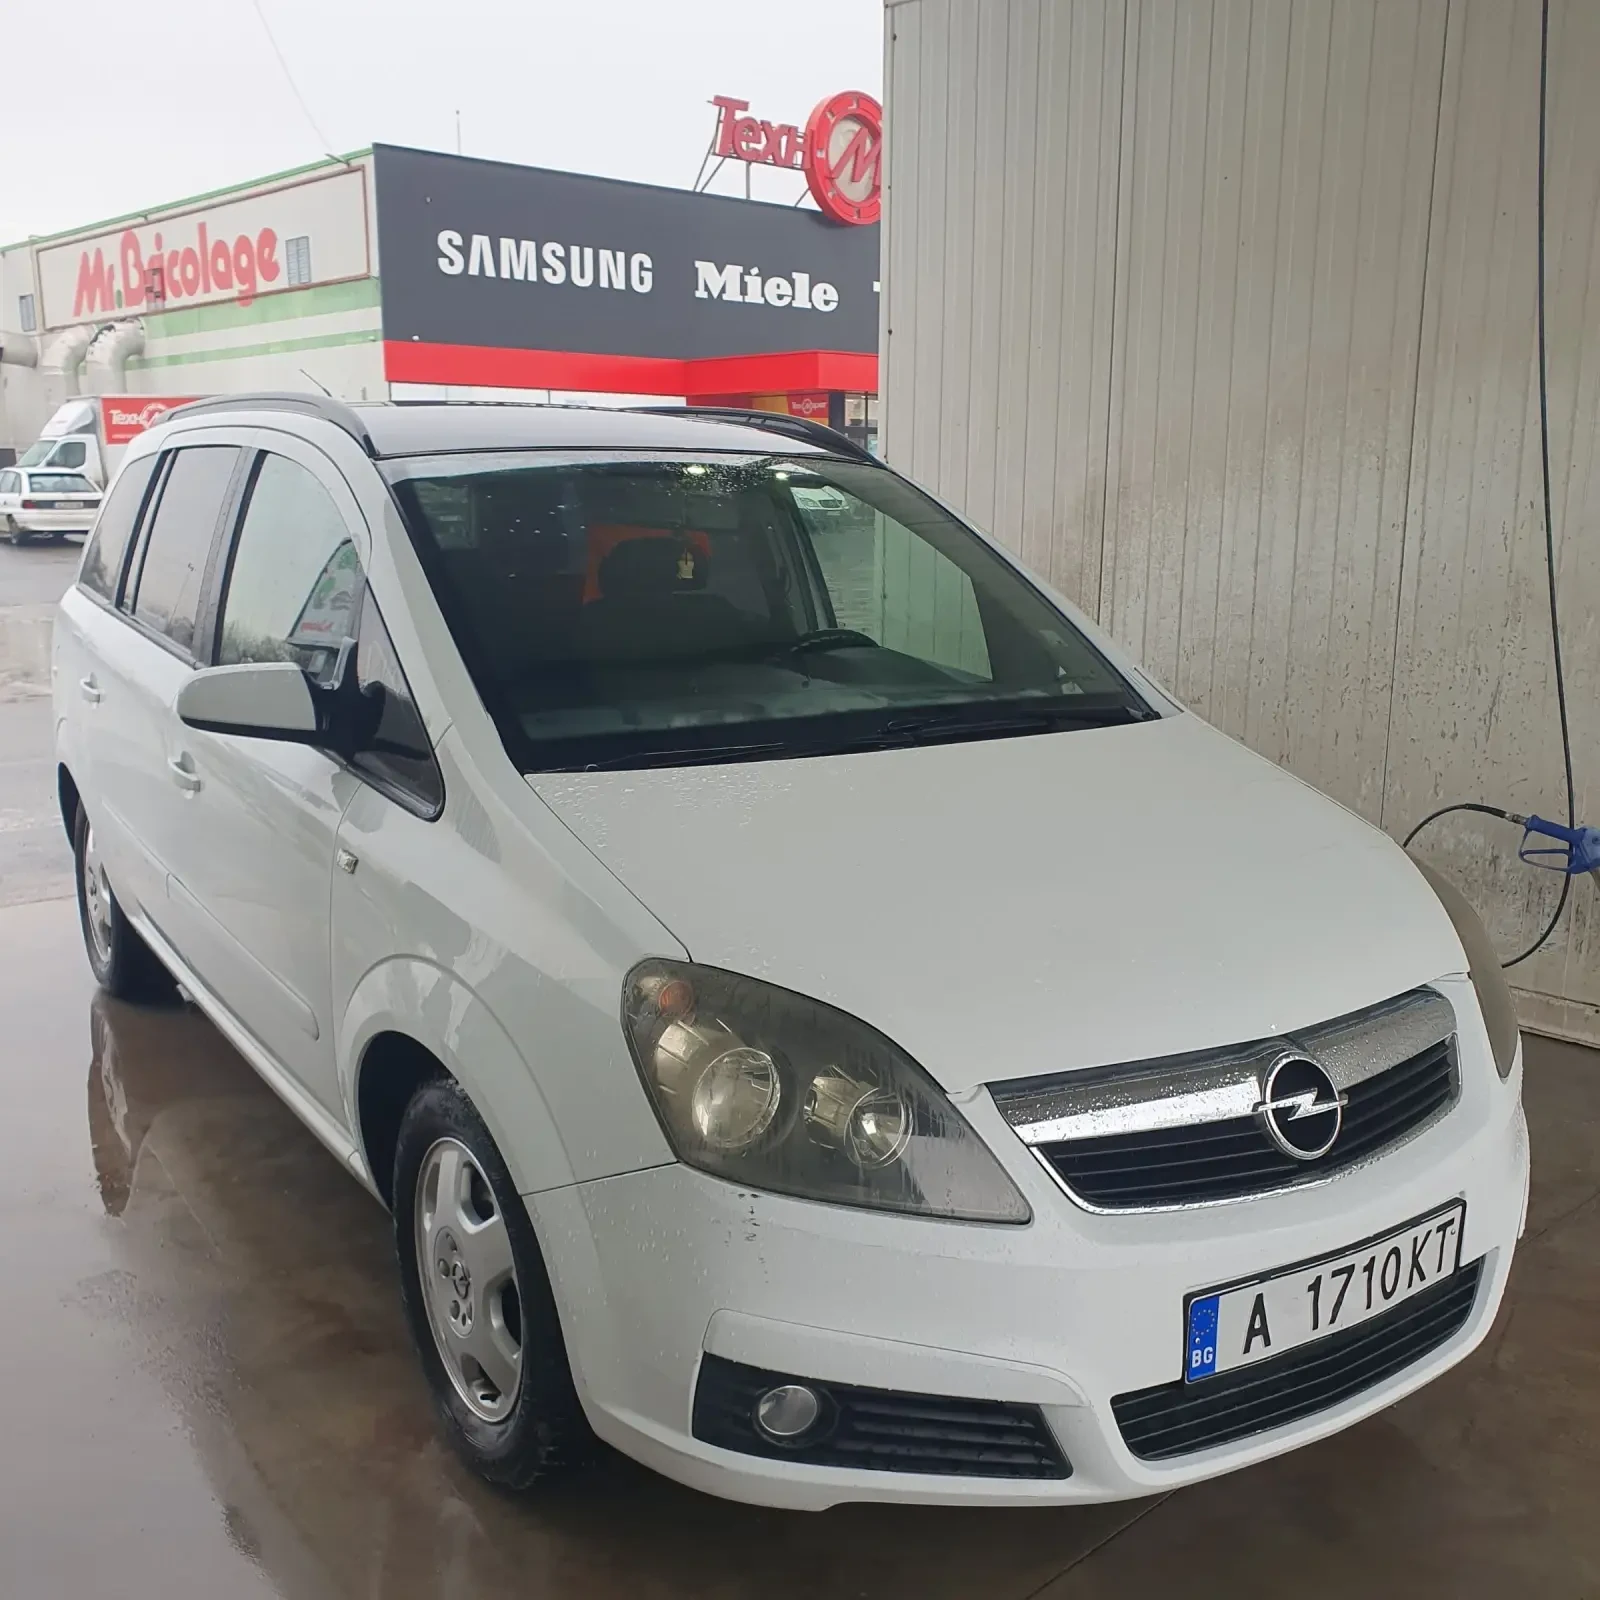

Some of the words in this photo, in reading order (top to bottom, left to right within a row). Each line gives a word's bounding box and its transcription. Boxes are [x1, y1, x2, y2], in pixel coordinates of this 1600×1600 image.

[437, 229, 653, 293] SAMSUNG
[694, 260, 839, 312] Miele
[1243, 1292, 1272, 1355] A
[1191, 1346, 1214, 1368] BG
